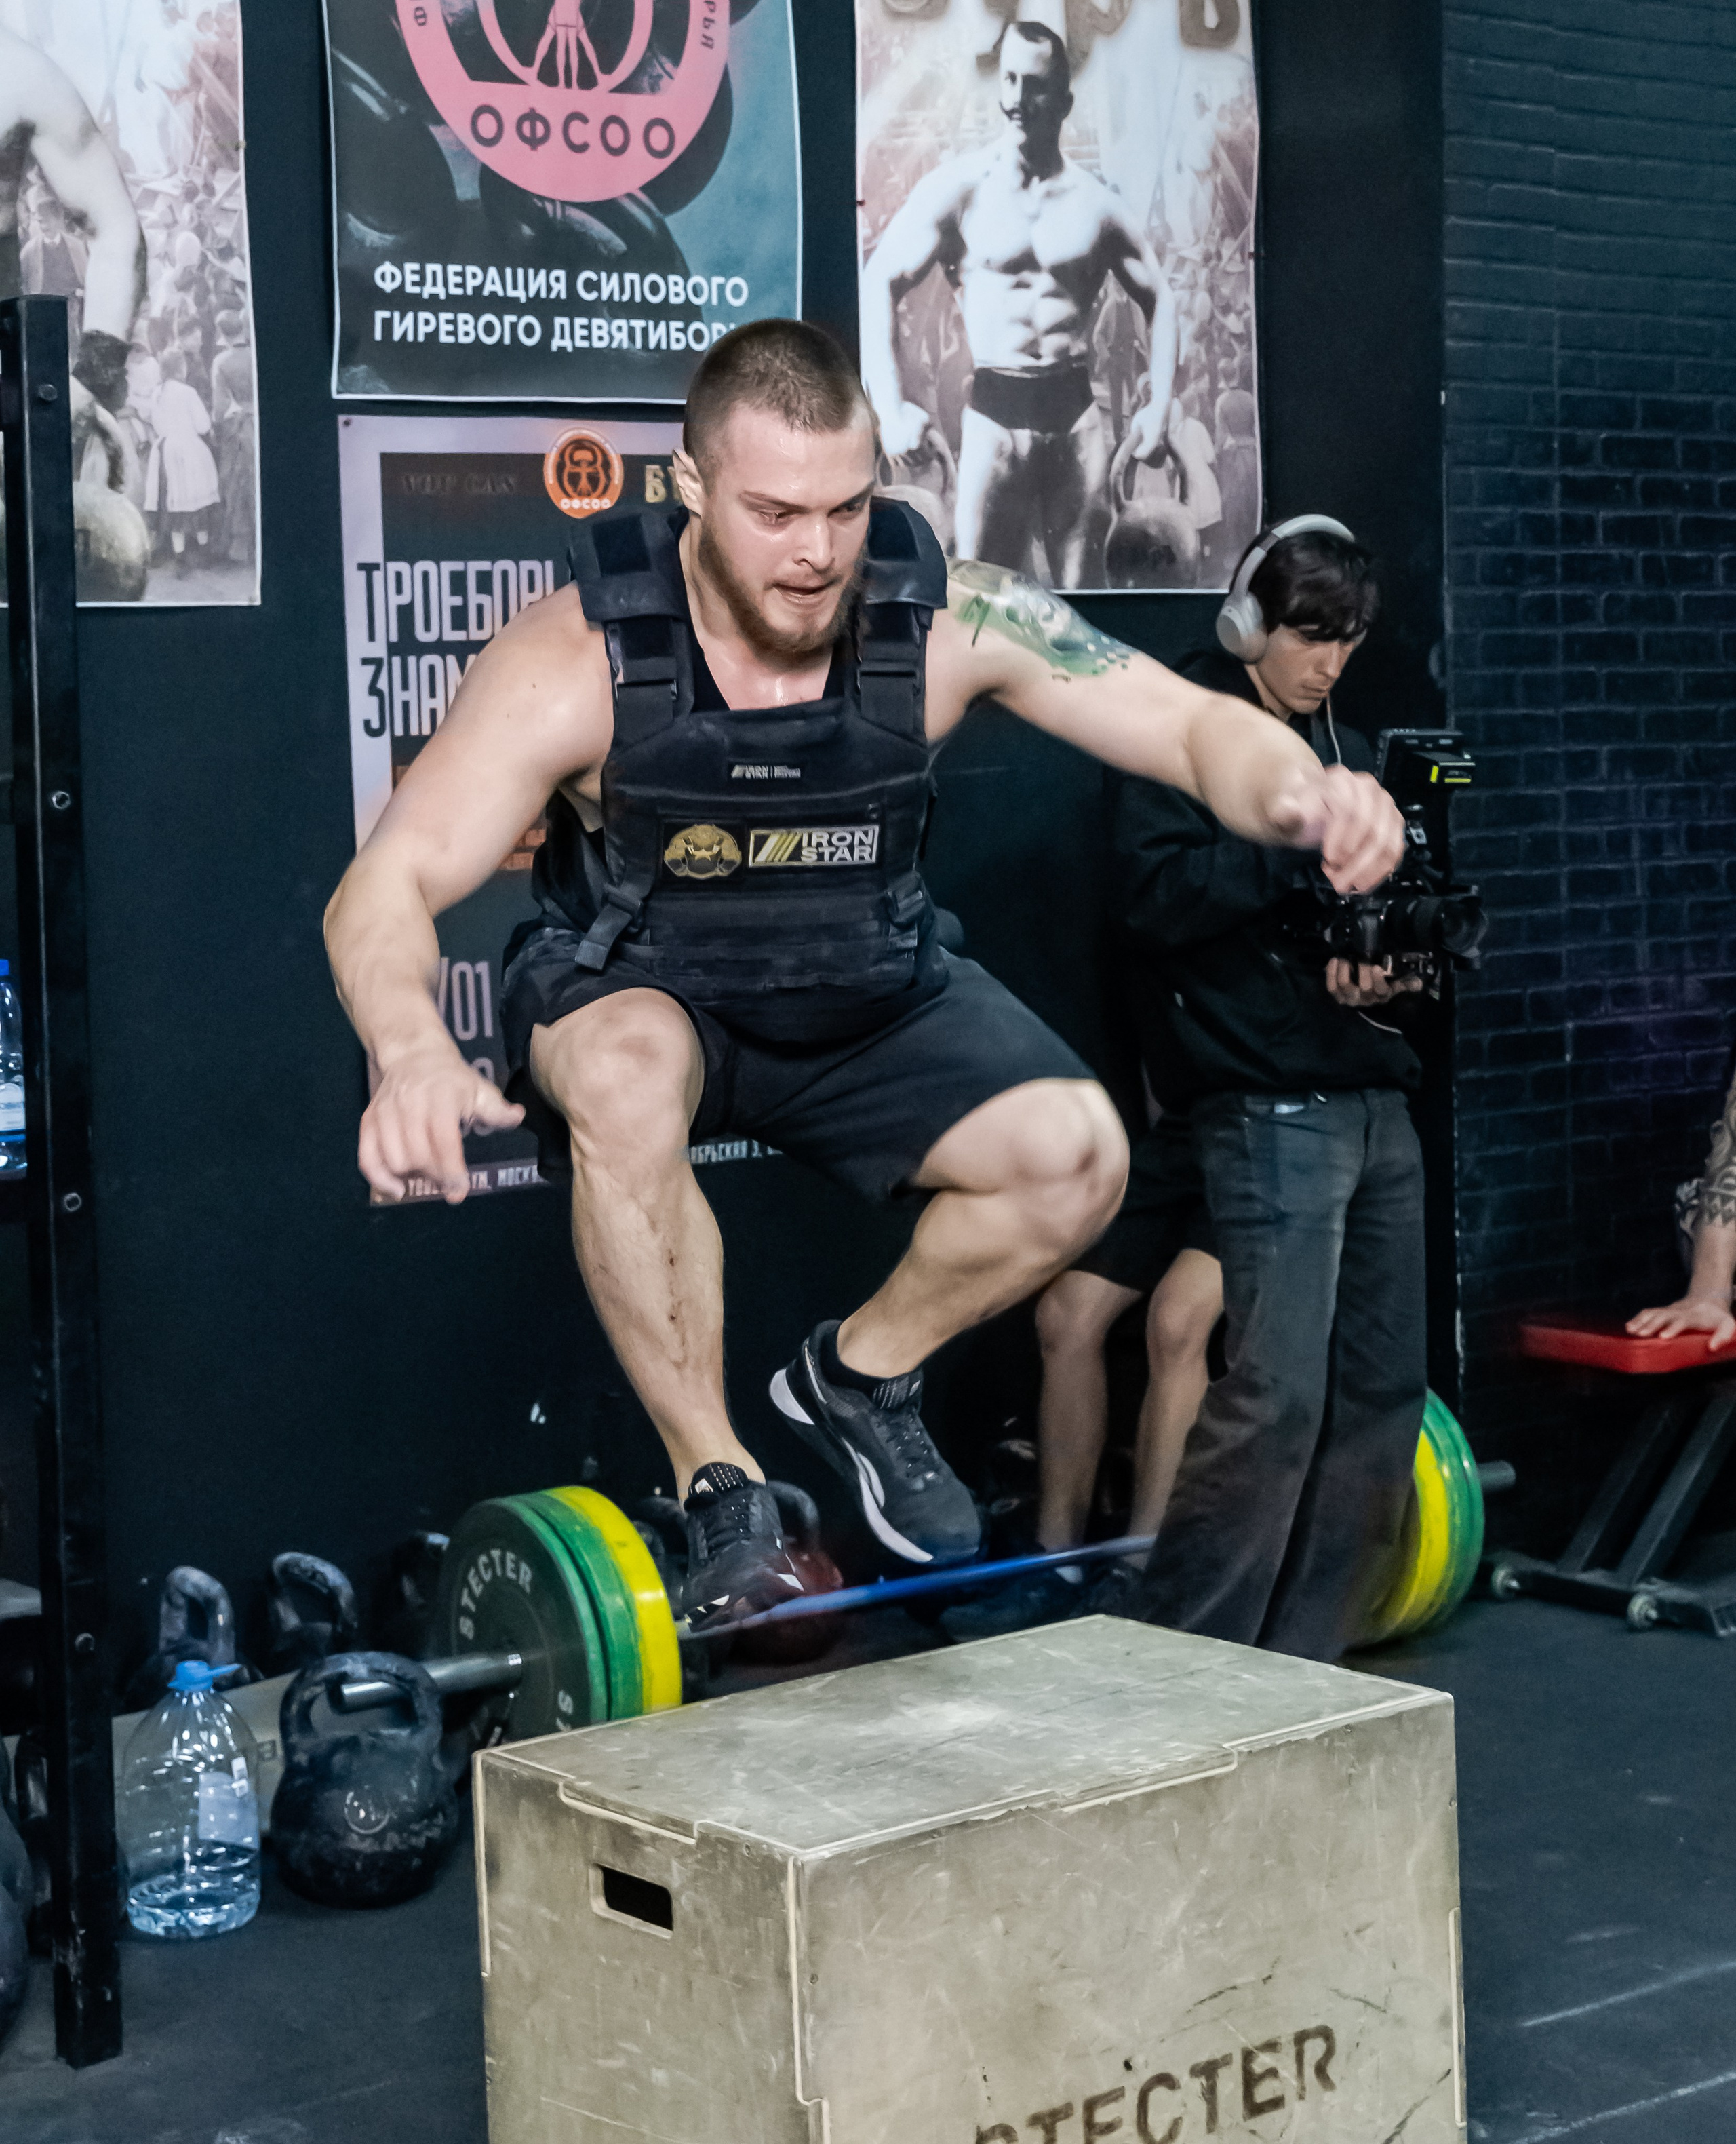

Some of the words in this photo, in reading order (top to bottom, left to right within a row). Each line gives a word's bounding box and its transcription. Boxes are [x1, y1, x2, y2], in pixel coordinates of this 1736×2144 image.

[470, 104, 676, 159] ОФСОО
[374, 261, 567, 303] ФЕДЕРАЦИЯ
[576, 269, 749, 307] СИЛОВОГО
[374, 310, 542, 347] ГИРЕВОГО
[551, 316, 736, 353] ДЕВЯТИБОР
[800, 845, 873, 863] STAR
[802, 828, 873, 848] IRON
